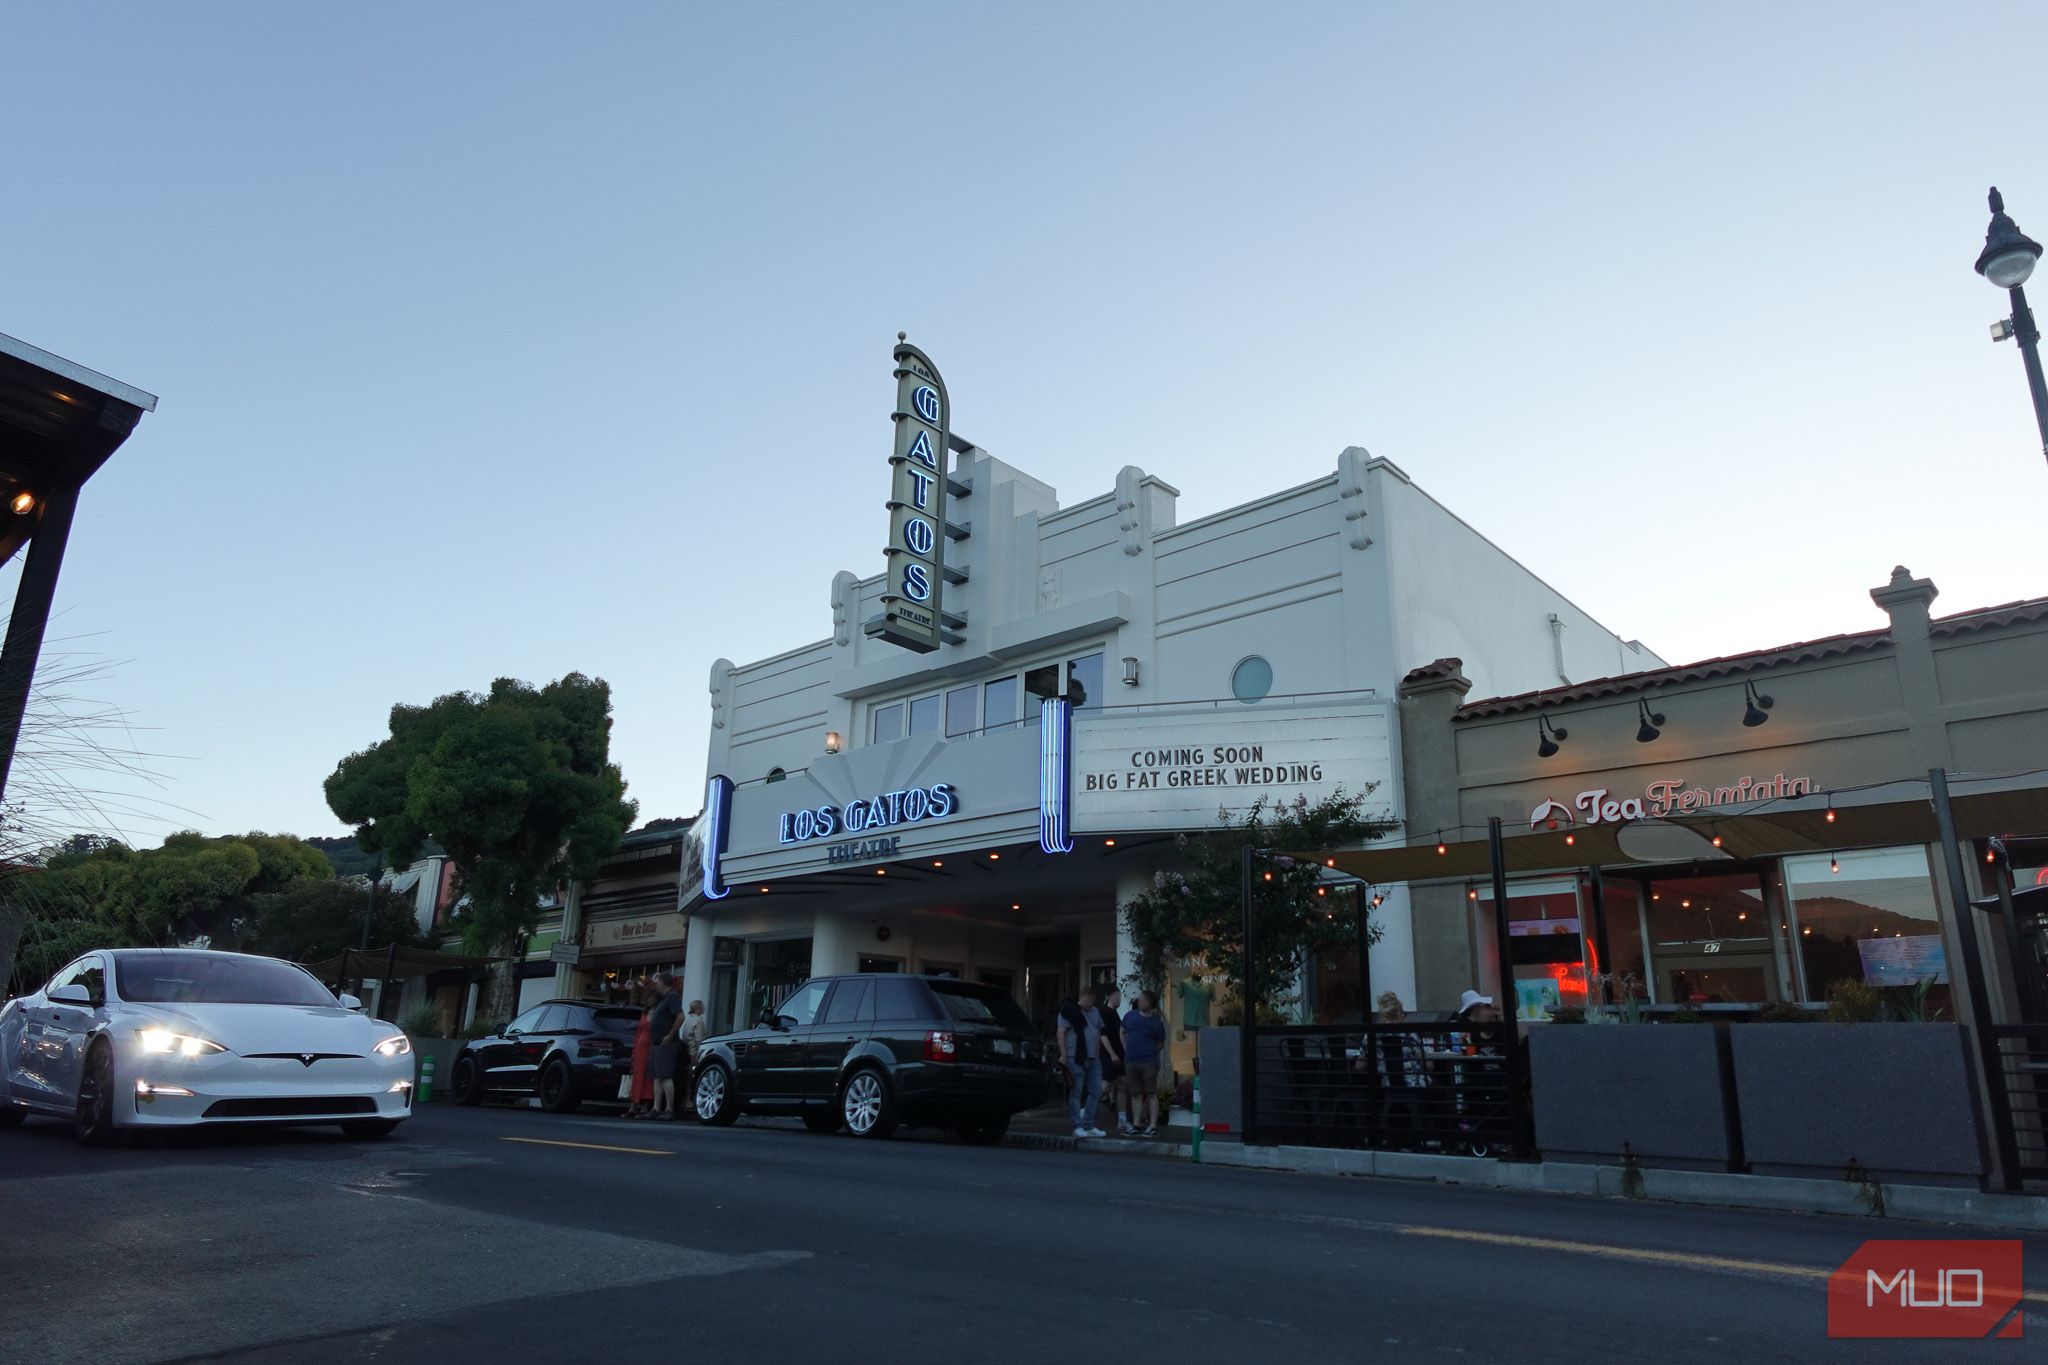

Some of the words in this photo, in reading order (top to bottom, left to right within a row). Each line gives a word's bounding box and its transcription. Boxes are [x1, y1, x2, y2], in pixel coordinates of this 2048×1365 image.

[902, 384, 940, 602] GATOS
[899, 607, 932, 625] THEATRE
[1131, 748, 1204, 768] COMING
[1214, 746, 1263, 764] SOON
[1086, 773, 1118, 791] BIG
[1126, 771, 1161, 789] FAT
[1167, 768, 1228, 787] GREEK
[1234, 764, 1323, 785] WEDDING
[779, 805, 843, 844] LOS
[843, 783, 960, 832] GATOS
[1575, 788, 1647, 824] Tea
[827, 836, 901, 865] THEATRE
[1704, 944, 1720, 953] 47
